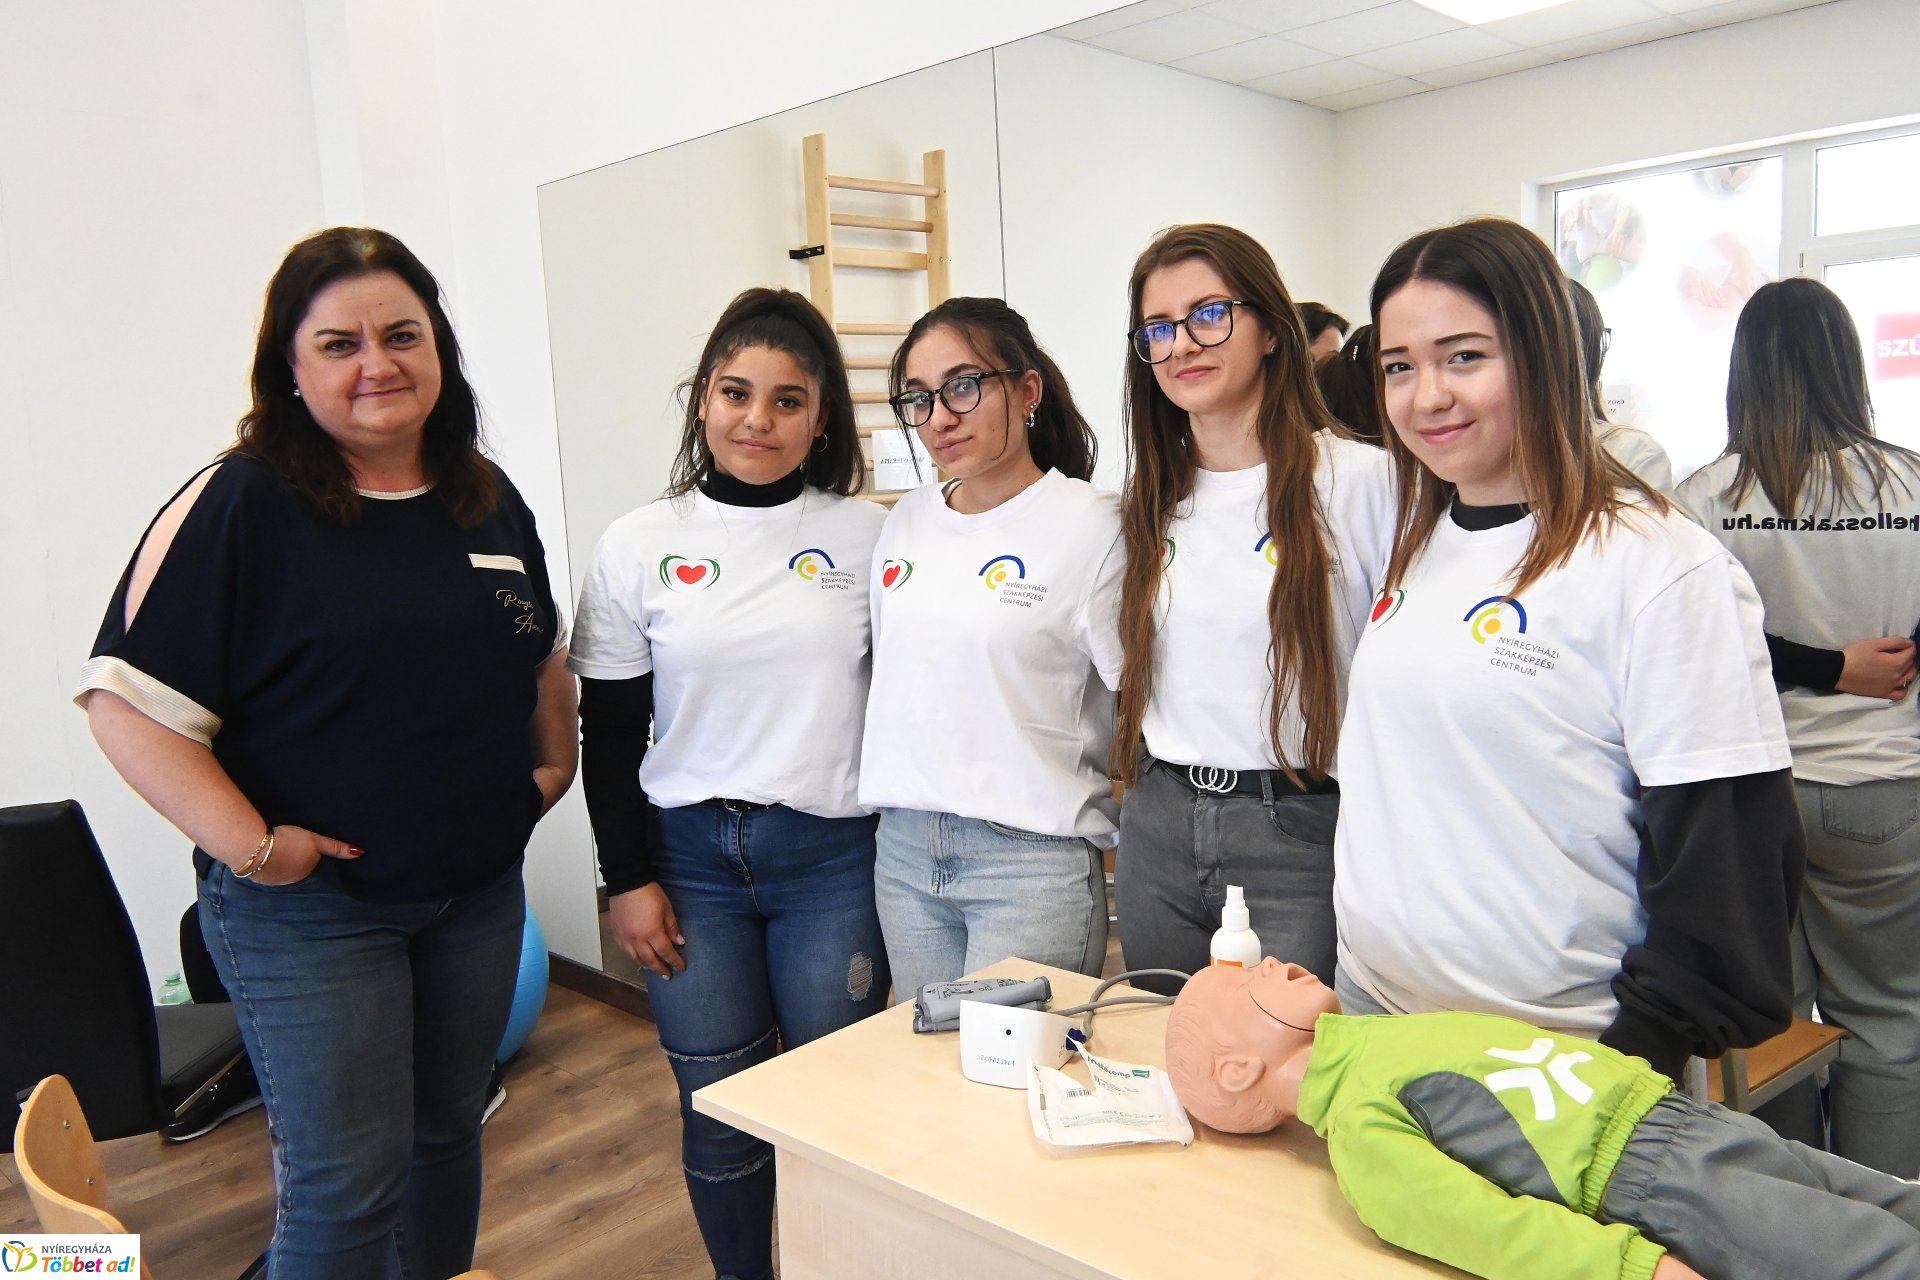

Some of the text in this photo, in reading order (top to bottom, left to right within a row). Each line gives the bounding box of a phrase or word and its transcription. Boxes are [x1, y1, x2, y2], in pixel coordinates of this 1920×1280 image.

[1005, 581, 1048, 593] NYÍREGYHÁZI
[999, 597, 1032, 608] CENTRUM
[1002, 589, 1044, 602] SZAKKÉPZÉSI
[1498, 636, 1560, 659] NYÍREGYHÁZI
[1493, 646, 1556, 670] SZAKKÉPZÉSI
[1490, 657, 1537, 677] CENTRUM
